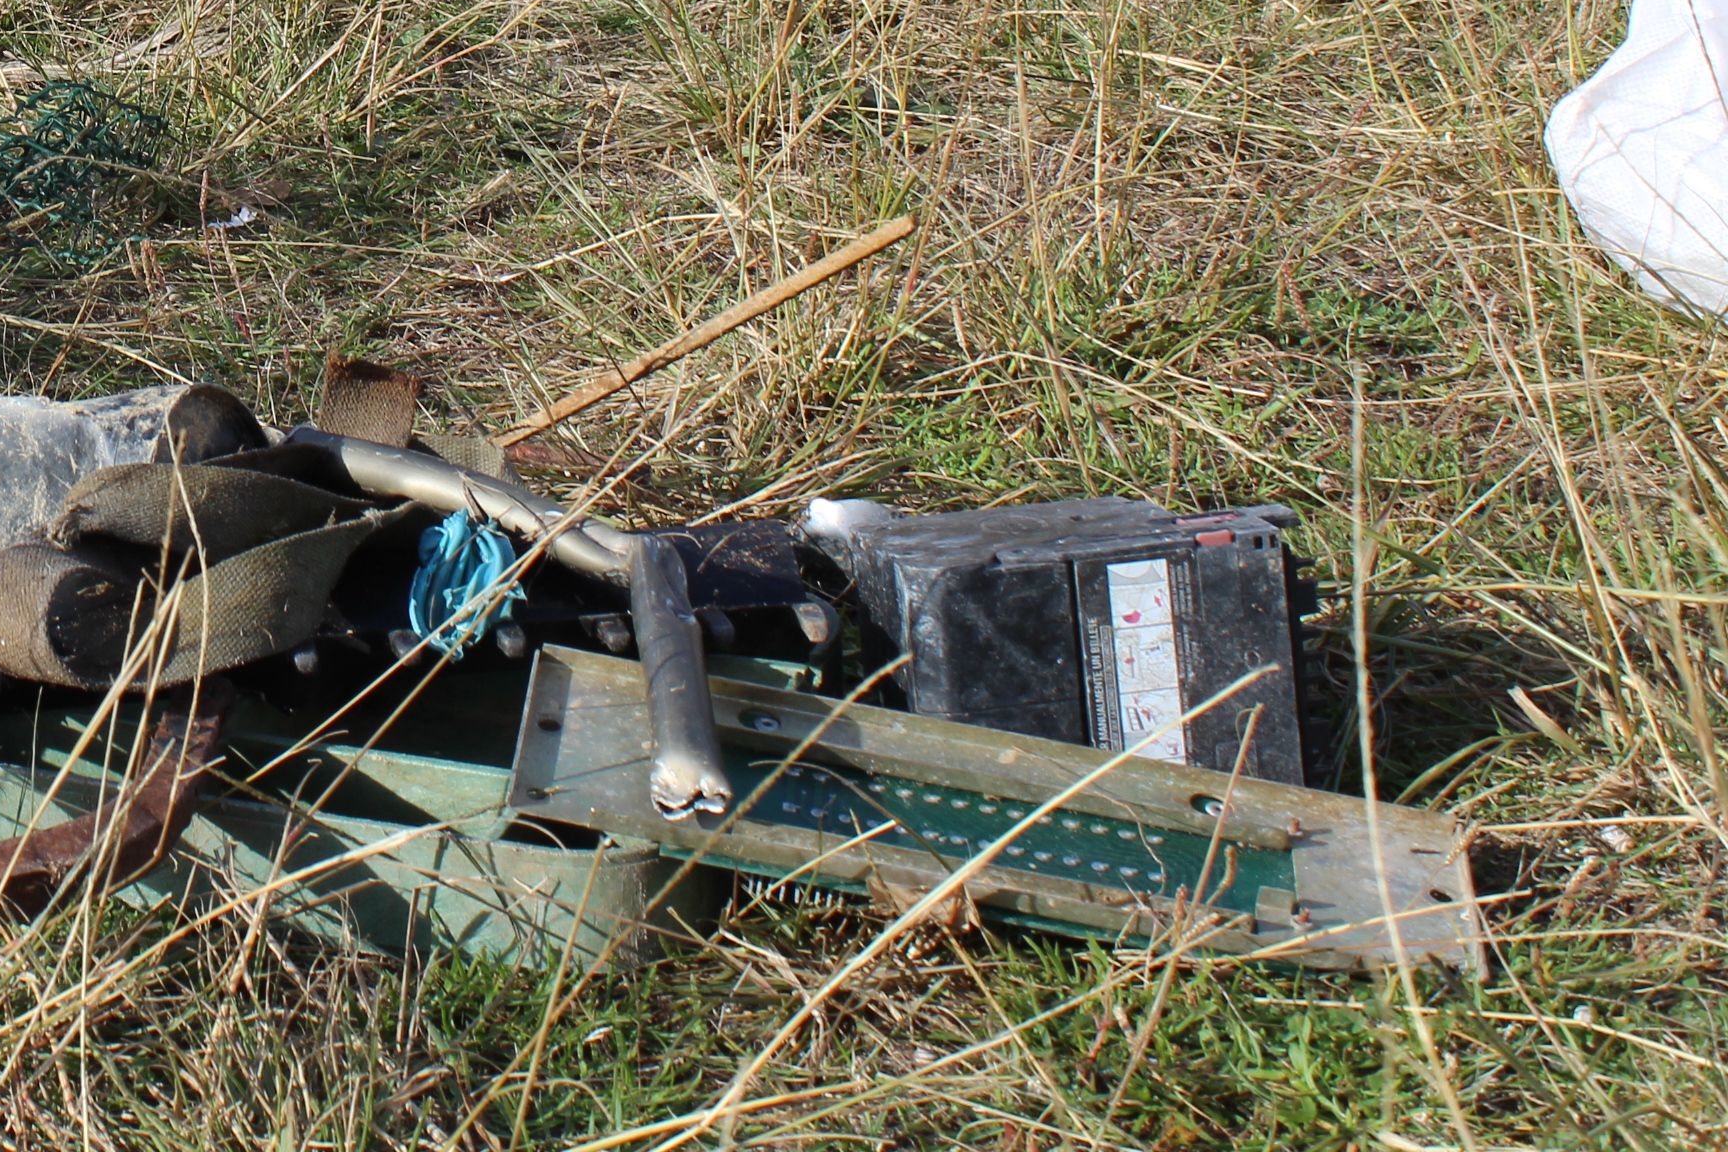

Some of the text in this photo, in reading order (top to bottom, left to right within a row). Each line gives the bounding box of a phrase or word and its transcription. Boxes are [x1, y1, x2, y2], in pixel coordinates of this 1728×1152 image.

[1087, 617, 1101, 654] BILLETE
[1091, 655, 1103, 669] UN
[1093, 671, 1110, 741] MANUALMENTE
